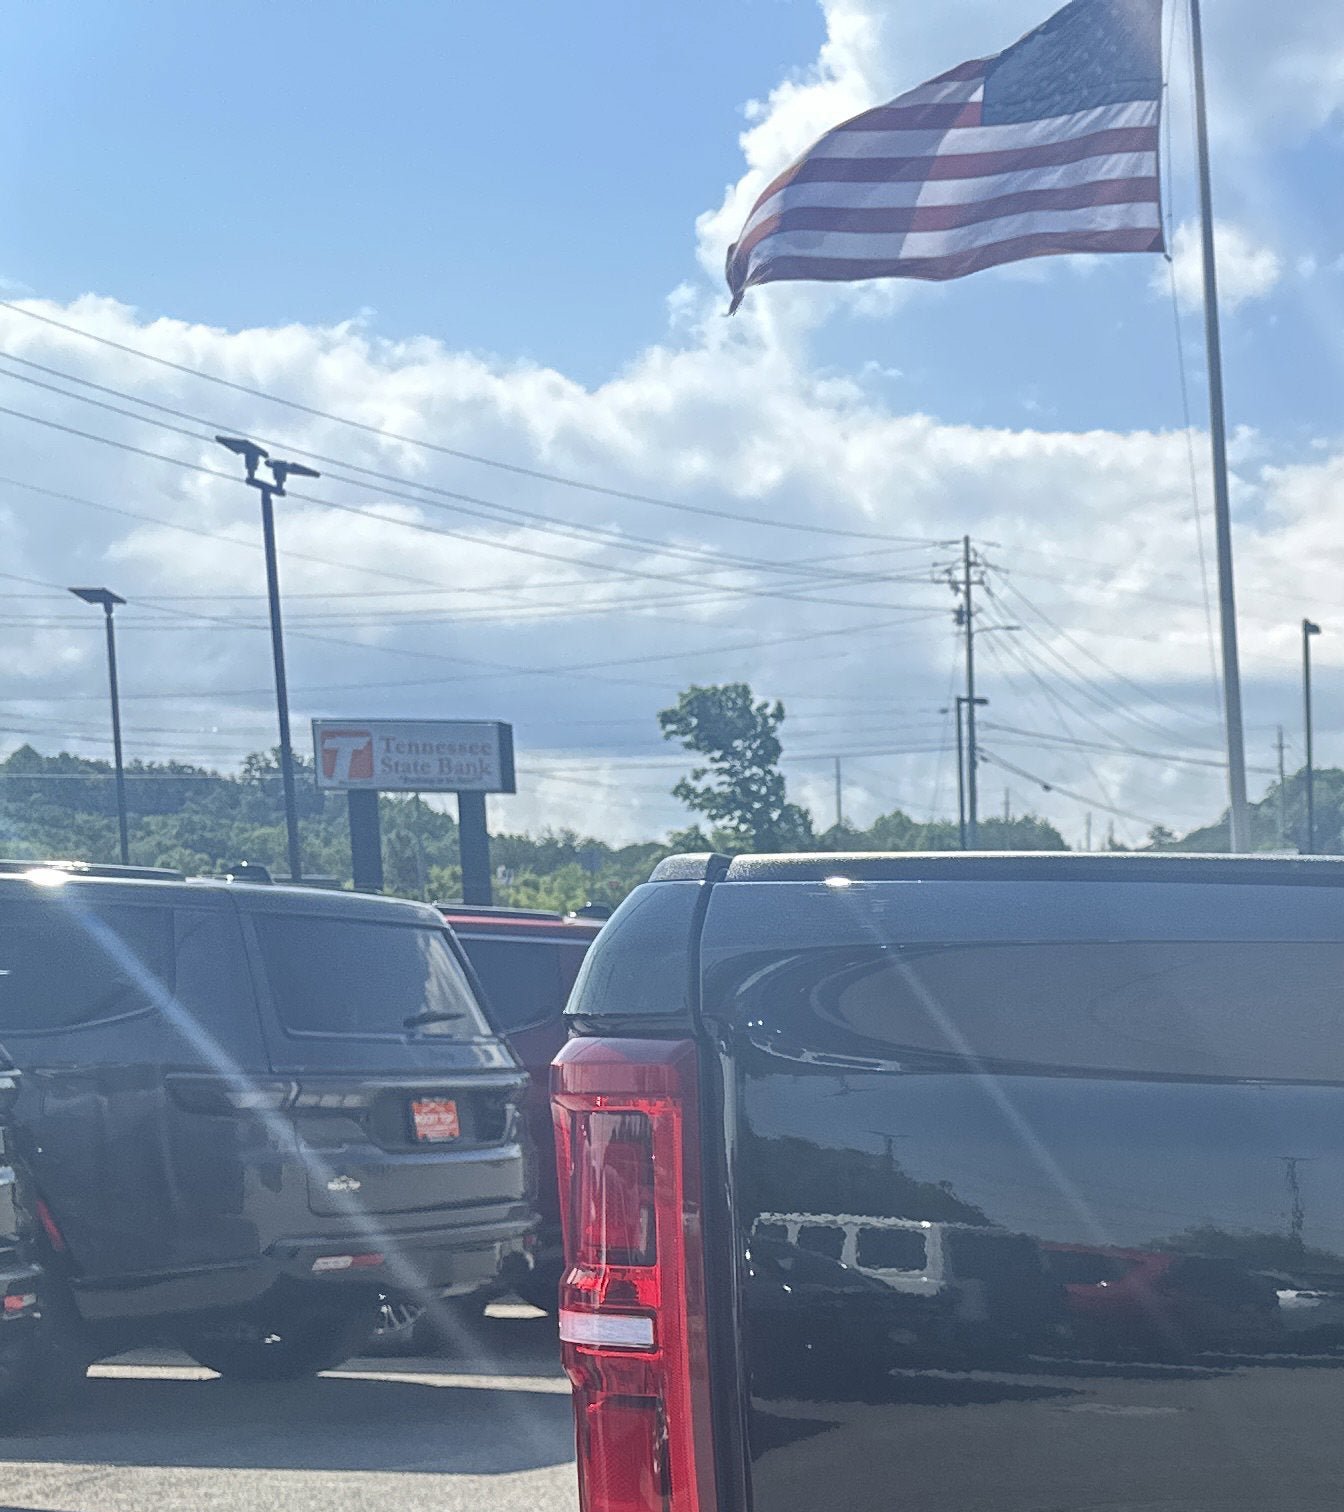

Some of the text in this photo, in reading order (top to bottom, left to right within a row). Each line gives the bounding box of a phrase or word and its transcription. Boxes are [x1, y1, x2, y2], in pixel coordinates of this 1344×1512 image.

[379, 736, 493, 756] Tennessee
[380, 755, 493, 776] State Bank
